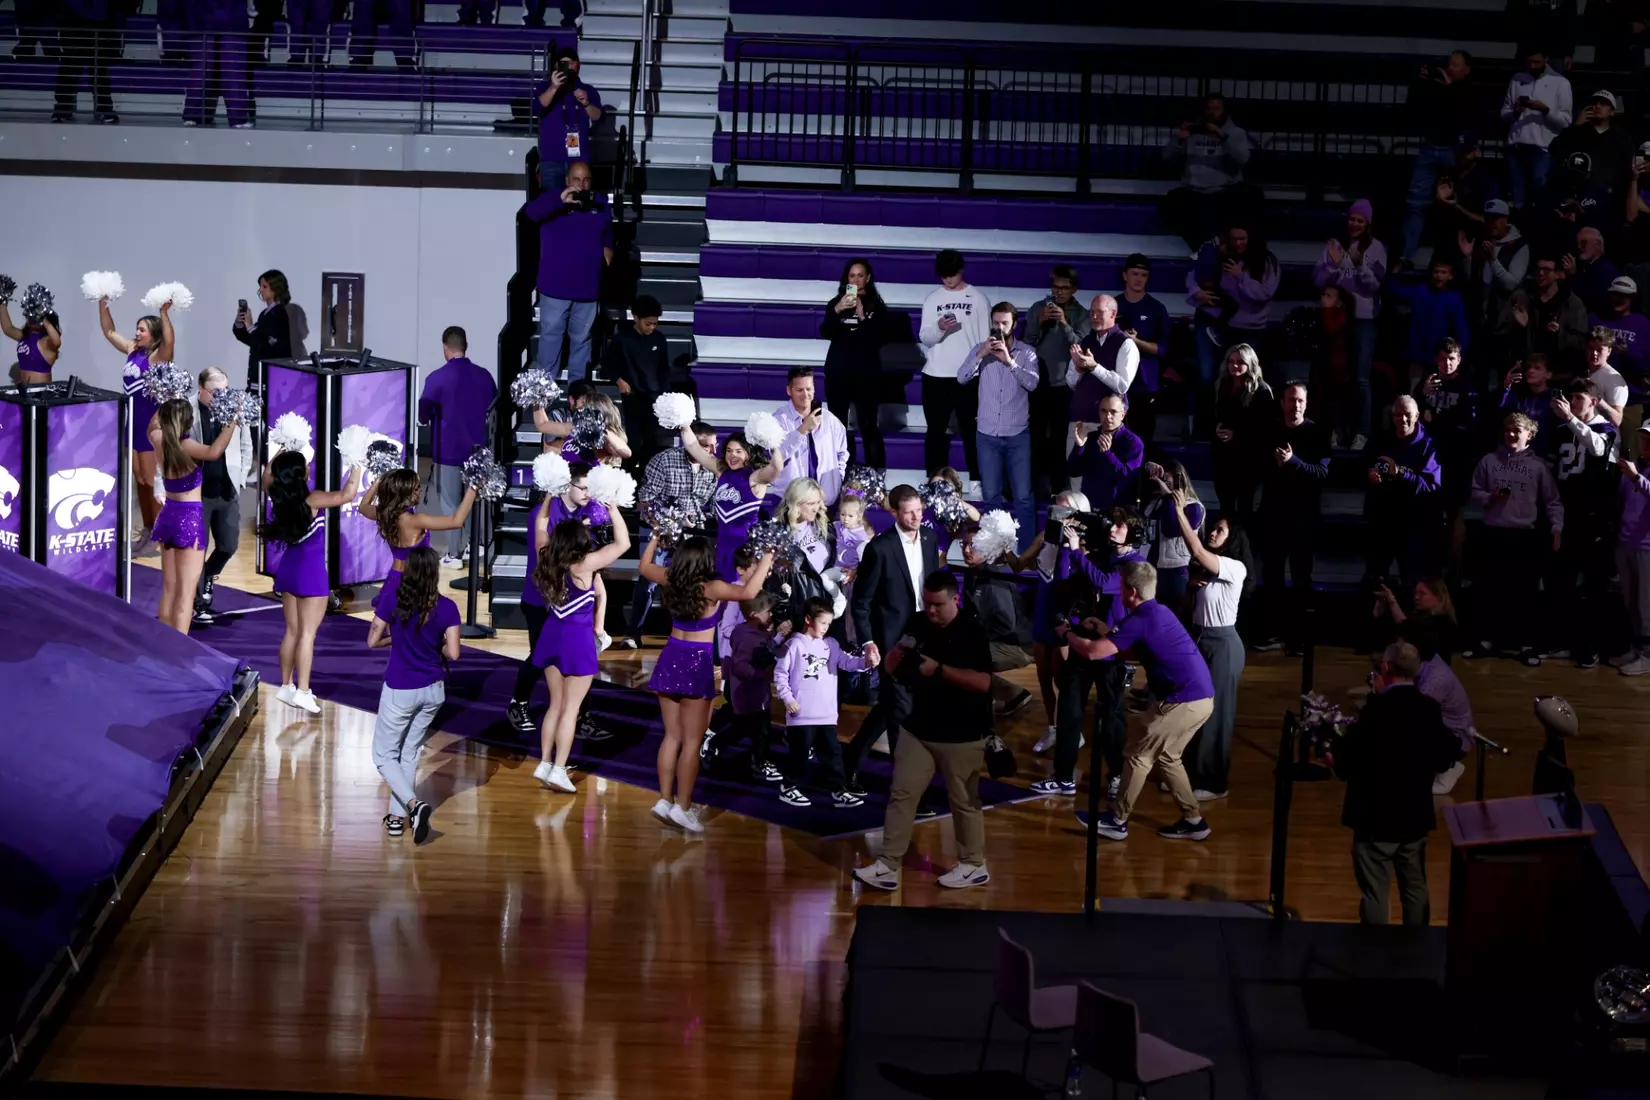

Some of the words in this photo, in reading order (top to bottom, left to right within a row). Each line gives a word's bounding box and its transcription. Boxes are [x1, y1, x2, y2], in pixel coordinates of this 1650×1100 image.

[937, 303, 972, 312] K-STATE
[1612, 328, 1636, 342] TATE
[516, 469, 524, 485] 1
[715, 482, 742, 504] Cats
[48, 527, 116, 550] K-STATE
[53, 542, 111, 556] WILDCATS
